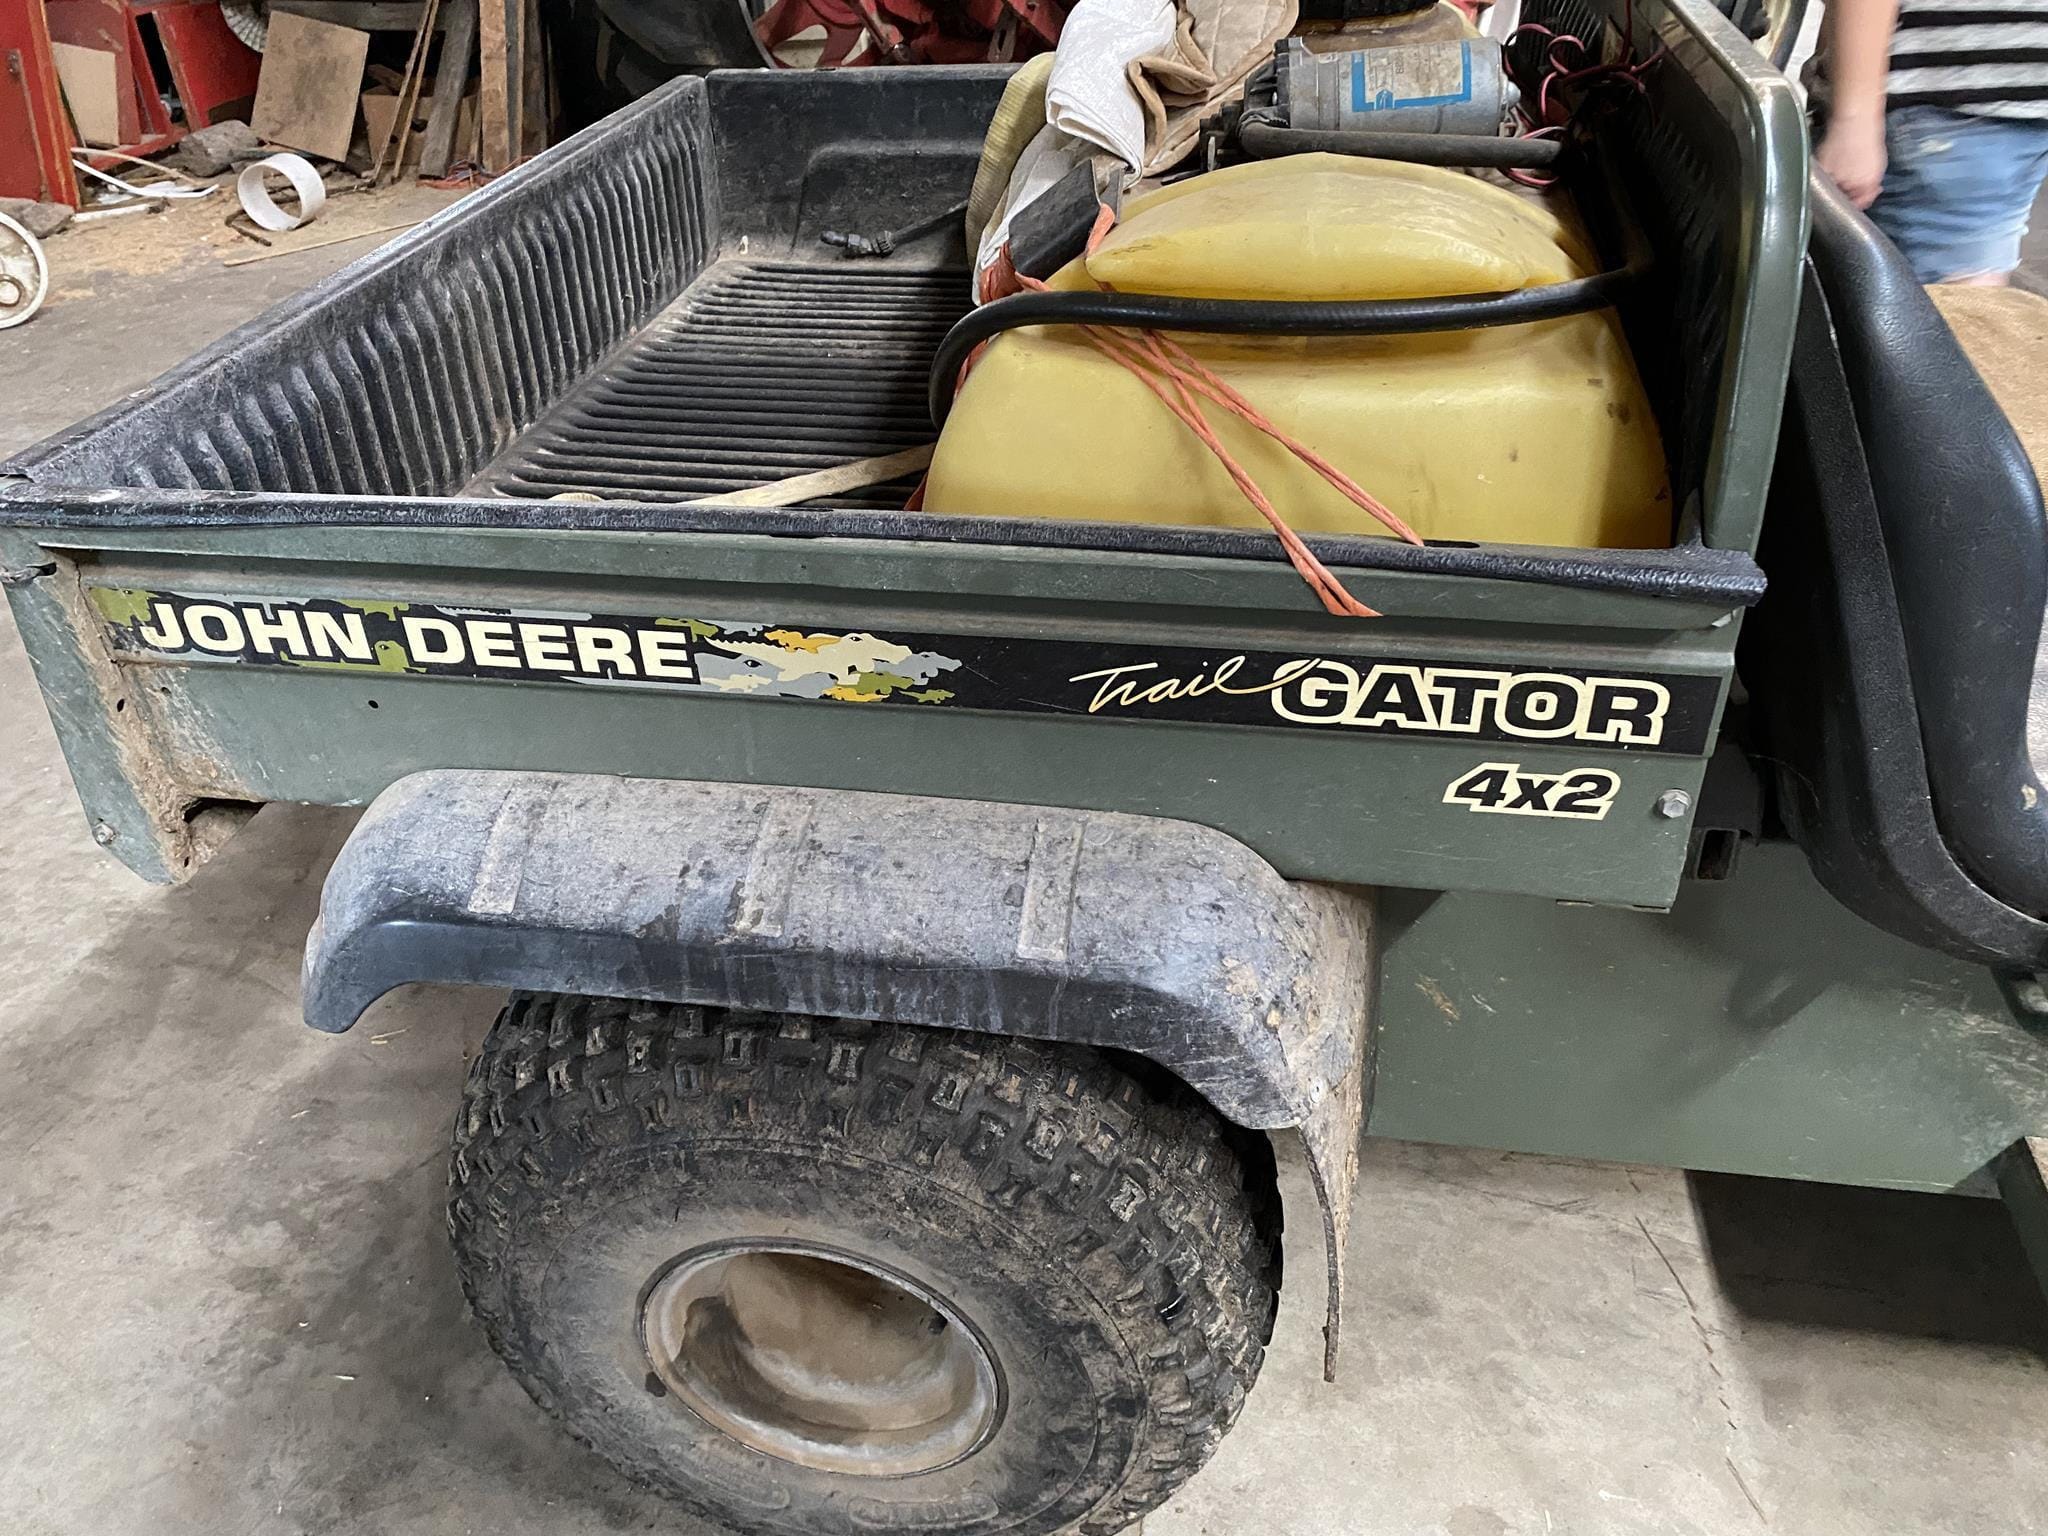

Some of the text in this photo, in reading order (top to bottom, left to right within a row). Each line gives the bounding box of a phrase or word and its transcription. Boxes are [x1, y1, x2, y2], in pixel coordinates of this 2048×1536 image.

[140, 603, 695, 679] JOHN DEERE
[1069, 655, 1671, 745] Trail GATOR
[1442, 763, 1621, 820] 4x2
